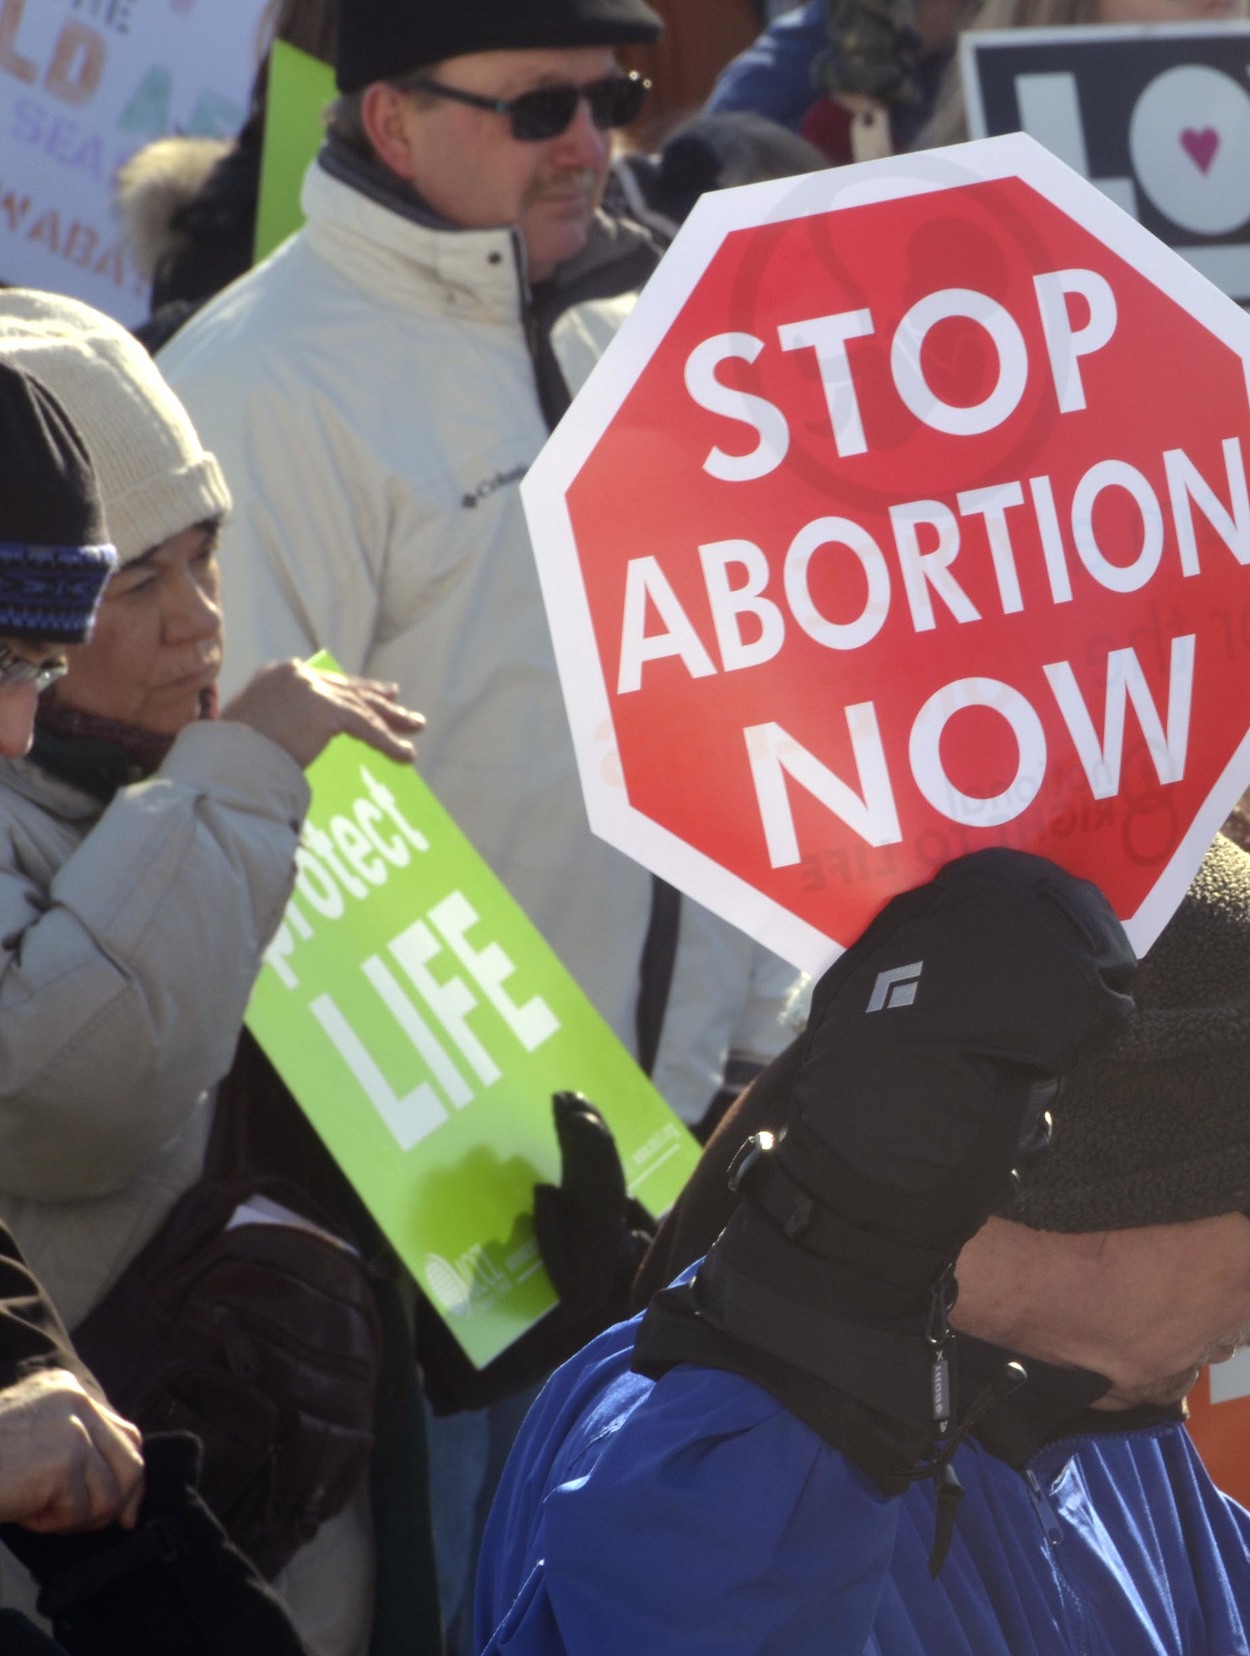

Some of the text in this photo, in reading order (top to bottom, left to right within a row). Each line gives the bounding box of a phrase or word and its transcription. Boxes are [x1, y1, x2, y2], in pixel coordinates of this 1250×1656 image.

[683, 268, 1118, 482] STOP
[742, 634, 1196, 869] NOW
[309, 890, 561, 1153] LIFE
